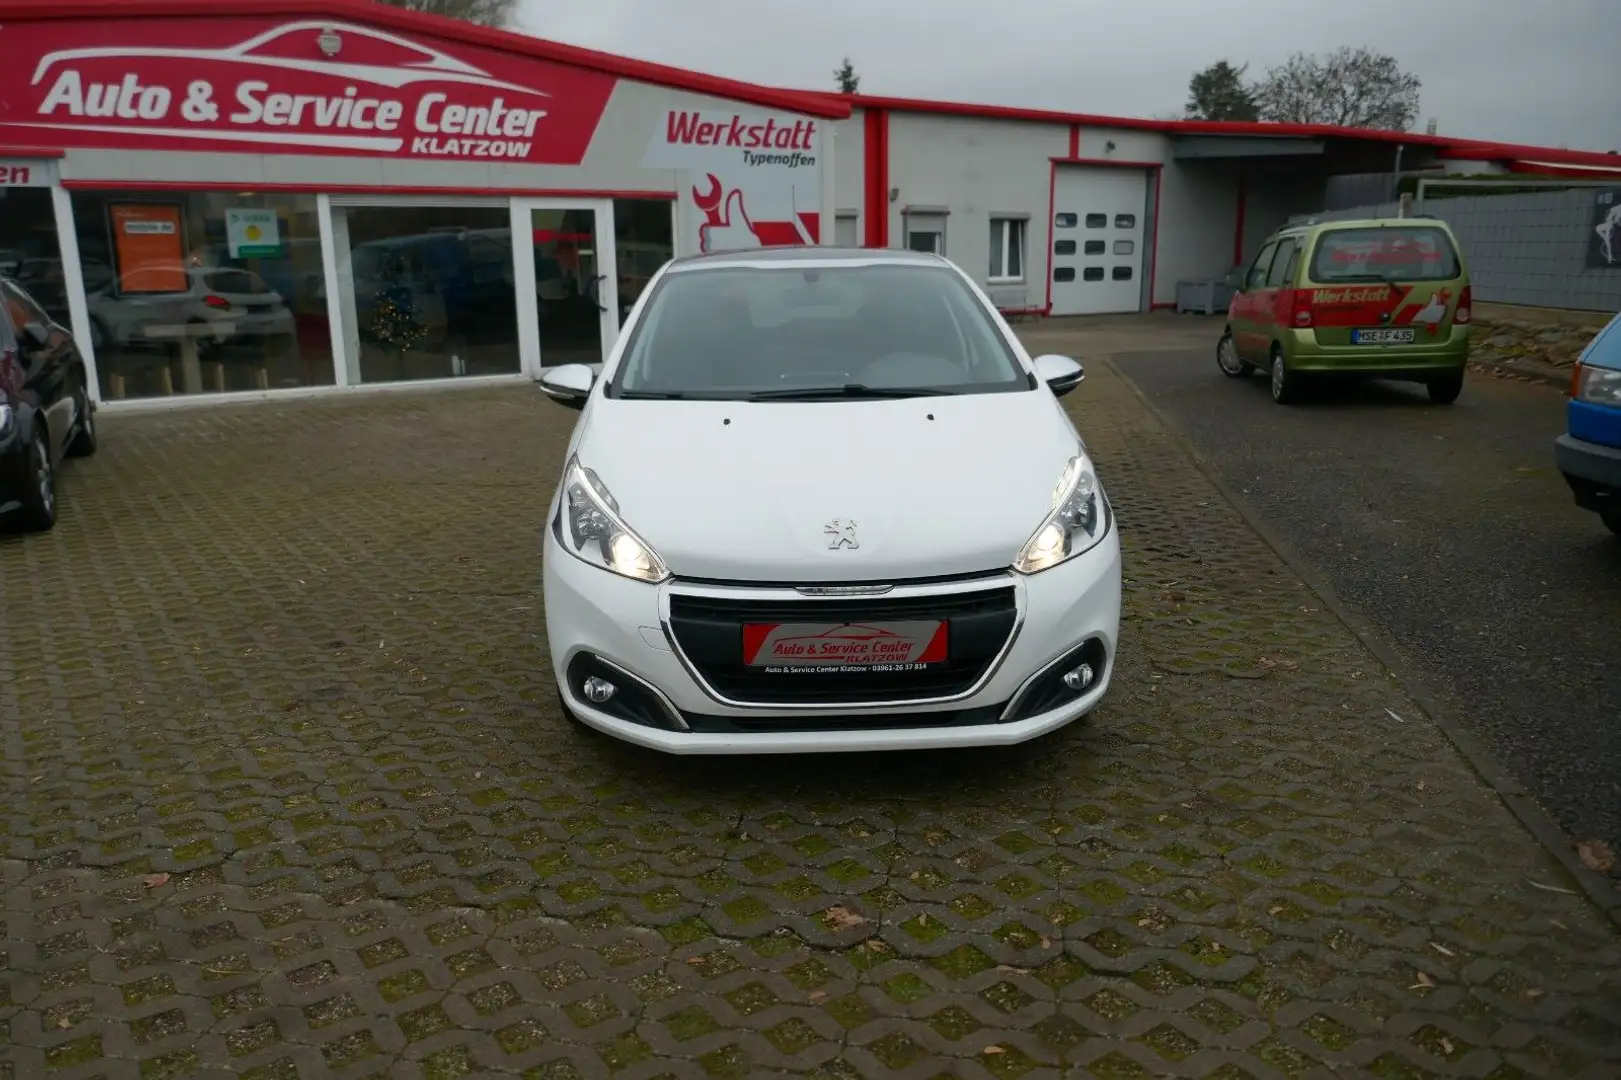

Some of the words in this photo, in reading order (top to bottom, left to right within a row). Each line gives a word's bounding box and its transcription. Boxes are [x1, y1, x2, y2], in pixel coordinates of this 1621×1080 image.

[36, 69, 171, 120] Auto
[181, 80, 219, 122] &
[229, 80, 403, 131] Service
[414, 92, 547, 137] Center
[666, 110, 816, 150] Werkstatt
[411, 137, 532, 158] KLATZOW
[743, 150, 816, 168] Typenoffen
[1312, 287, 1390, 304] Werkstatt
[772, 643, 804, 655] Auto
[807, 643, 817, 655] &
[820, 641, 868, 655] Service
[871, 640, 916, 653] Center
[845, 653, 909, 663] KLATZOW
